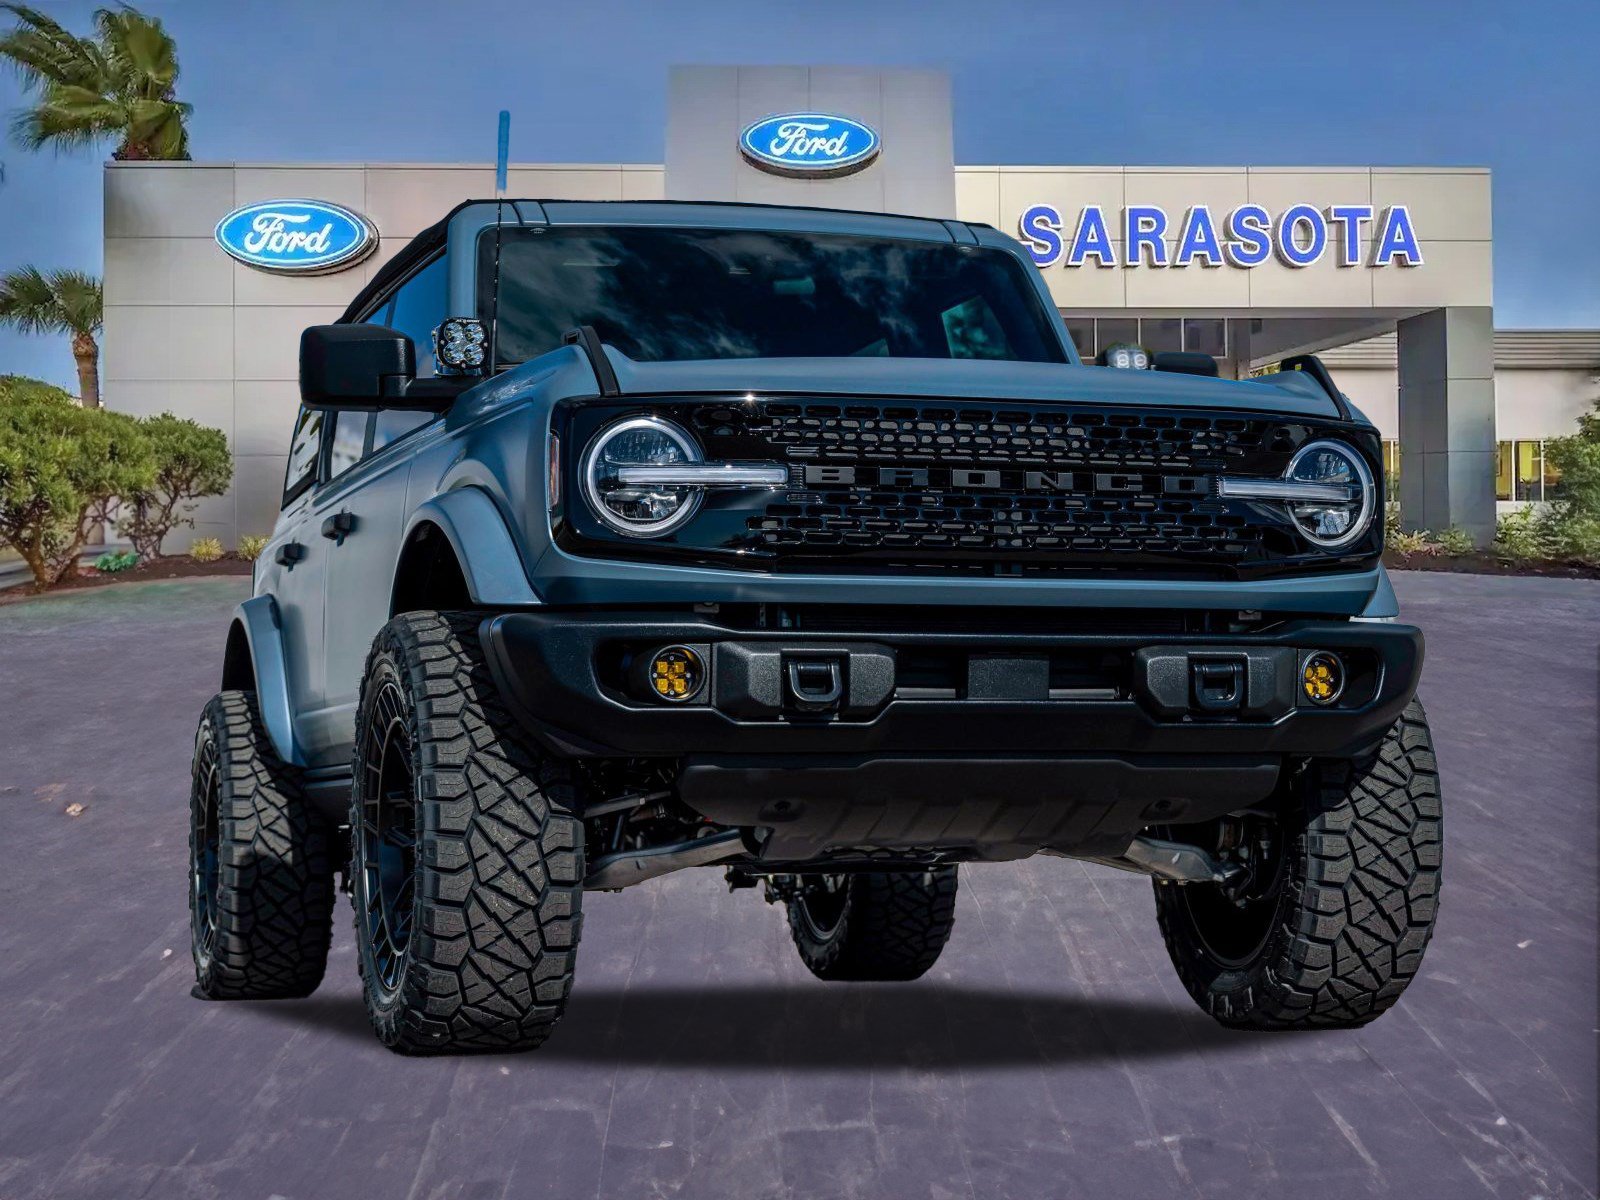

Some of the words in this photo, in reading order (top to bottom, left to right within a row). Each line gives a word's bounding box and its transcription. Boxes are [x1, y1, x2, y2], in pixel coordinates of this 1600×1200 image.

[770, 122, 849, 156] Ford
[244, 212, 333, 254] Ford
[1019, 203, 1425, 268] SARASOTA
[805, 465, 1210, 494] BRONCO
